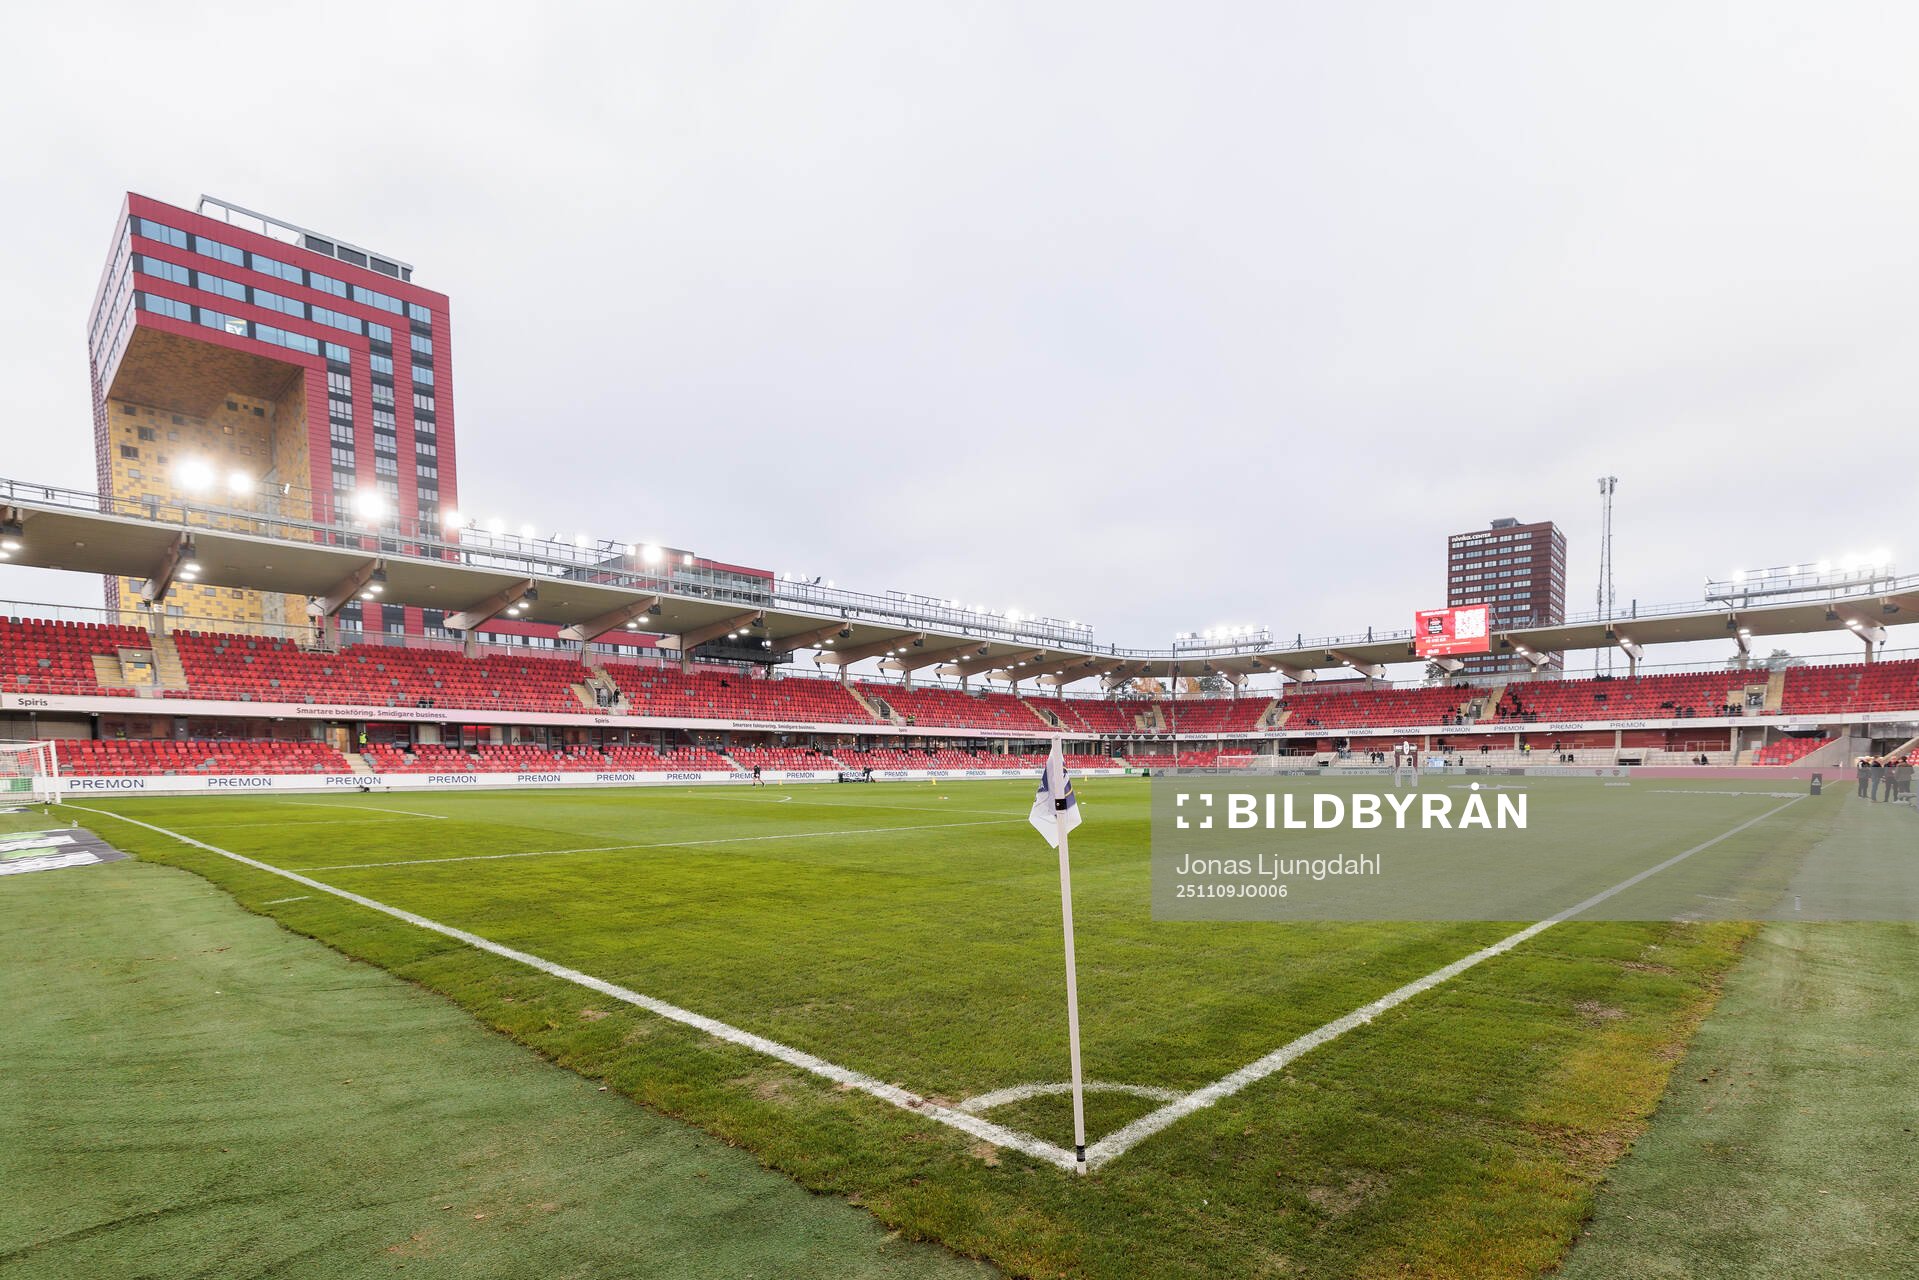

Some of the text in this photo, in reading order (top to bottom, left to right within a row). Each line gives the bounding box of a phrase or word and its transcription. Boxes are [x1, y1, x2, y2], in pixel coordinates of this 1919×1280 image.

[18, 698, 48, 707] Spiris
[296, 707, 333, 715] Smartare
[377, 710, 414, 718] Smidigare
[415, 711, 448, 719] business.
[70, 779, 144, 789] PREMON
[208, 778, 272, 787] PREMON
[326, 776, 381, 785] PREMON
[428, 775, 477, 784] PREMON
